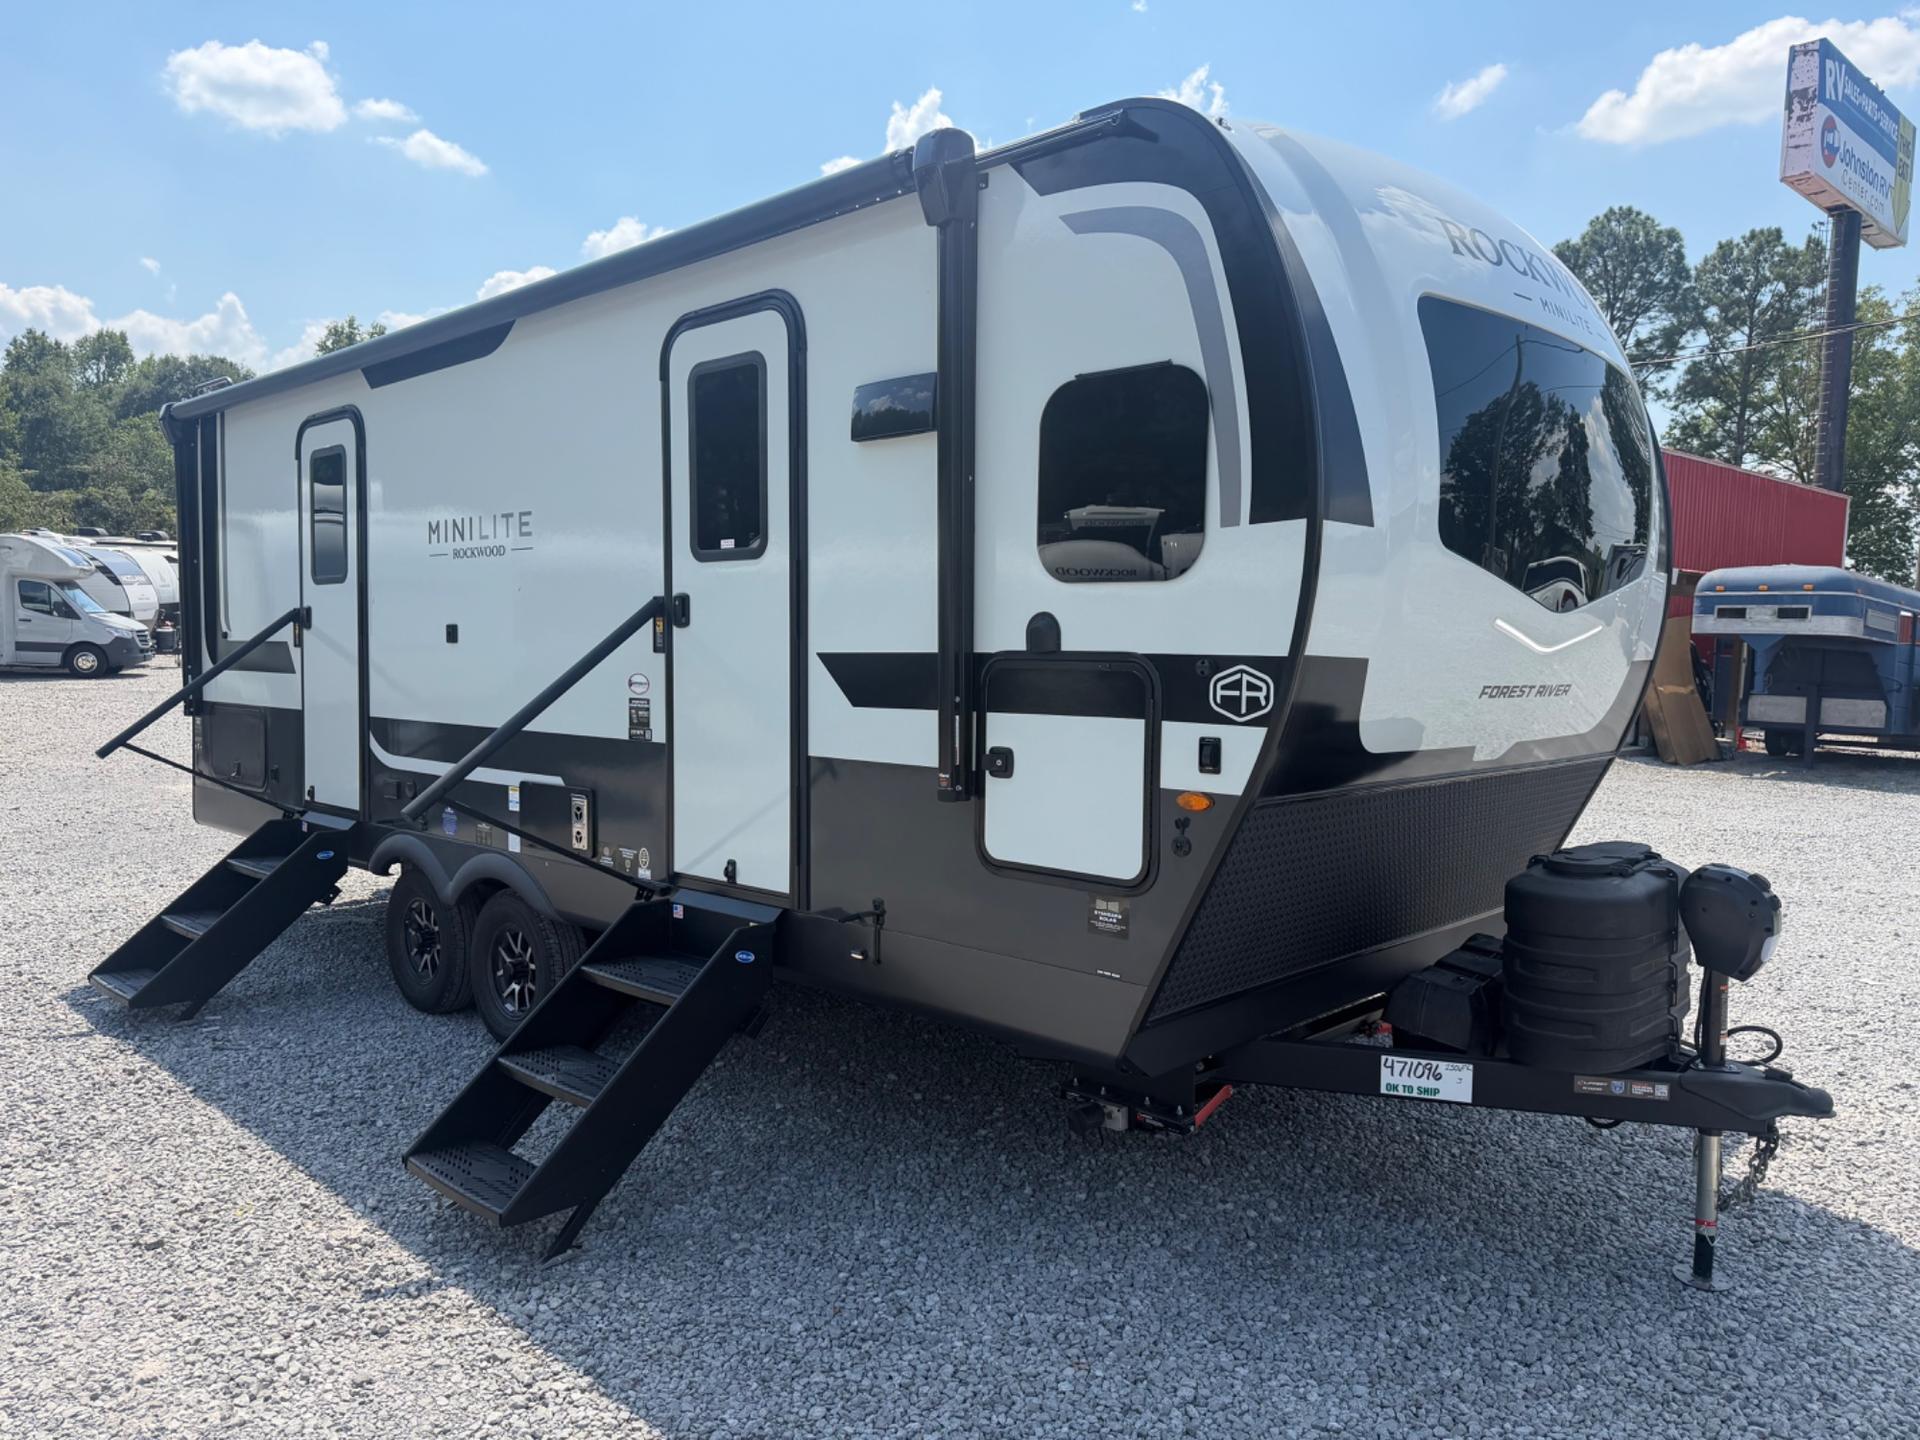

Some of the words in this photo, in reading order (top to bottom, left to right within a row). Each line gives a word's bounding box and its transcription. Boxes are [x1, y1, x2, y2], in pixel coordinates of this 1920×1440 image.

[1826, 59, 1845, 102] RV
[1839, 140, 1879, 192] Johnston
[1879, 175, 1891, 200] RV
[1842, 168, 1885, 214] Center.com
[1435, 216, 1588, 310] ROCKWO
[1539, 296, 1593, 336] MINILITE
[428, 510, 533, 545] MINILITE
[452, 544, 506, 560] ROCKWOOD
[1478, 684, 1537, 699] FOREST
[1534, 683, 1573, 698] RIVER
[1383, 1057, 1443, 1081] 471096
[1385, 1082, 1400, 1093] OK
[1401, 1084, 1414, 1095] TO
[1416, 1086, 1441, 1097] SHIP
